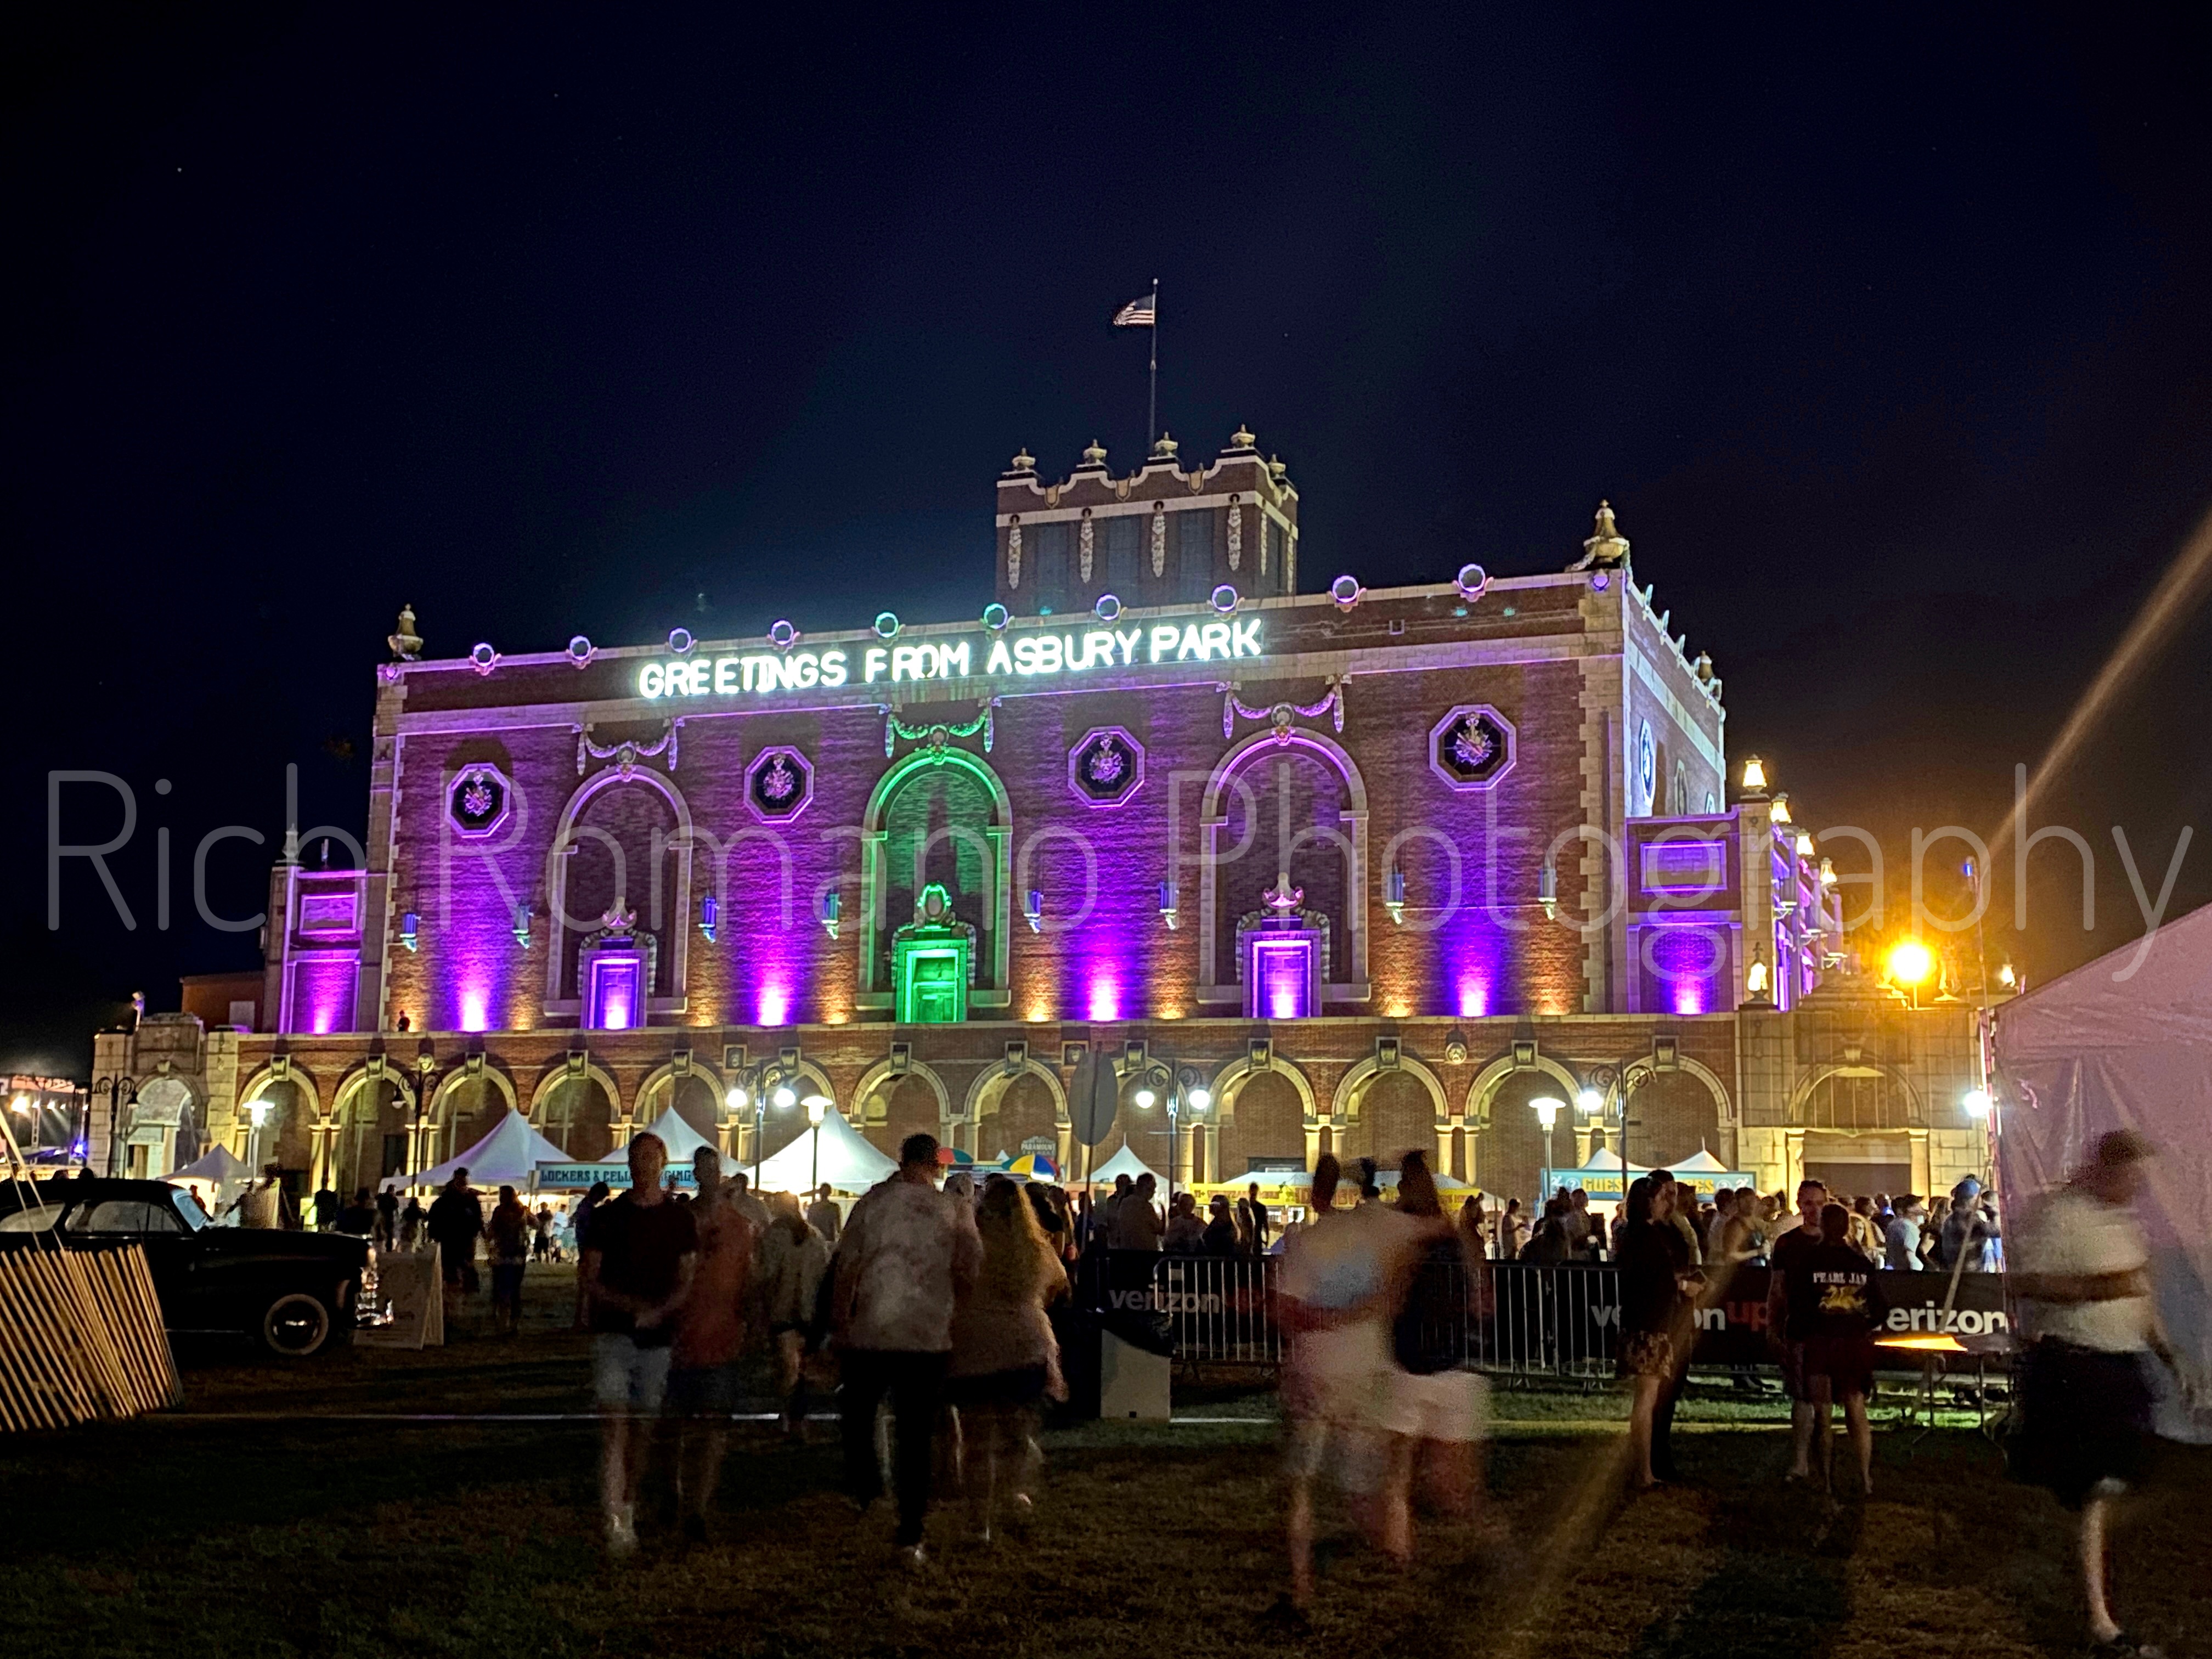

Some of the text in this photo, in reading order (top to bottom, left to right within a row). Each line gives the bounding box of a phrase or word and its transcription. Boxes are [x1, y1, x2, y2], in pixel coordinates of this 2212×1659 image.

[639, 618, 1261, 698] GREETINGS FROM ASBURY PARK
[541, 1170, 591, 1182] LOCKERS
[594, 1170, 600, 1182] &
[1813, 1272, 1845, 1283] PEARL
[1109, 1284, 1220, 1314] verizon
[1872, 1301, 2006, 1334] erizon
